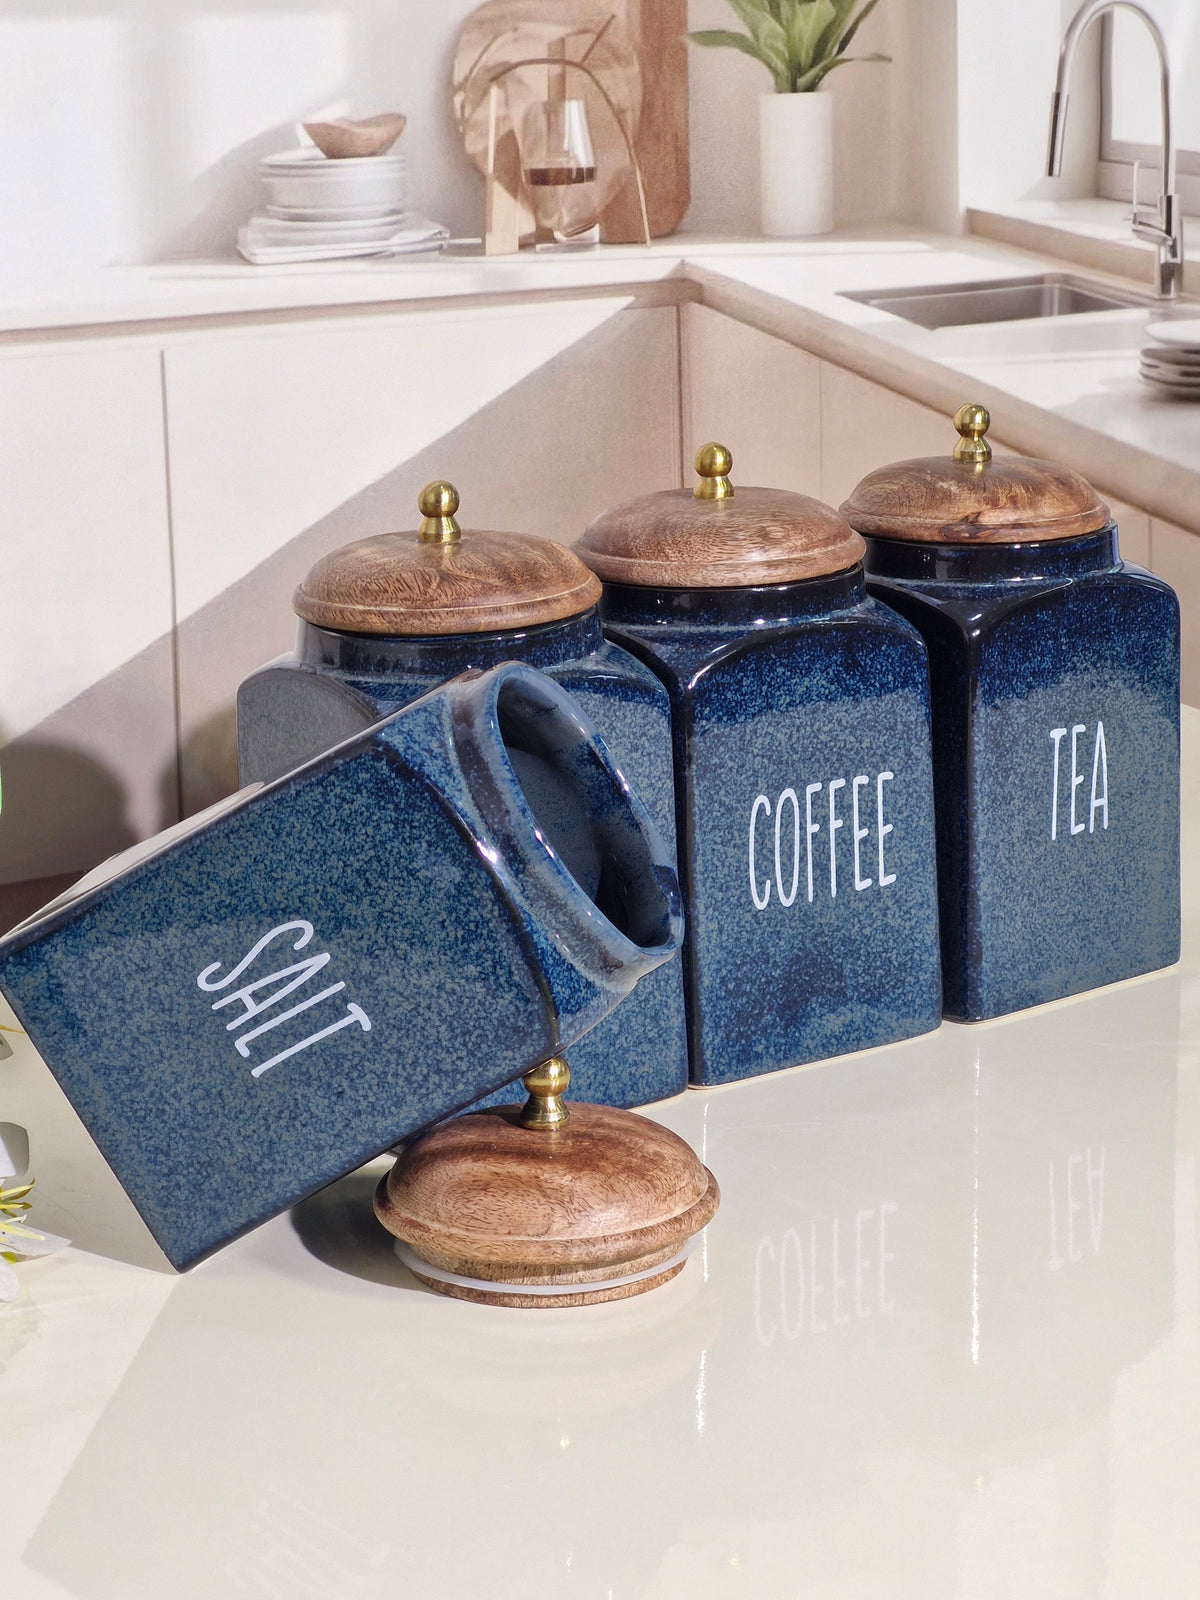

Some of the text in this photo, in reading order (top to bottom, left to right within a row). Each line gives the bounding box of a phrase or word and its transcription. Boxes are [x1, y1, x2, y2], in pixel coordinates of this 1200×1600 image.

[749, 771, 896, 910] COFFEE
[1050, 721, 1108, 840] TEA
[197, 920, 371, 1078] SALT
